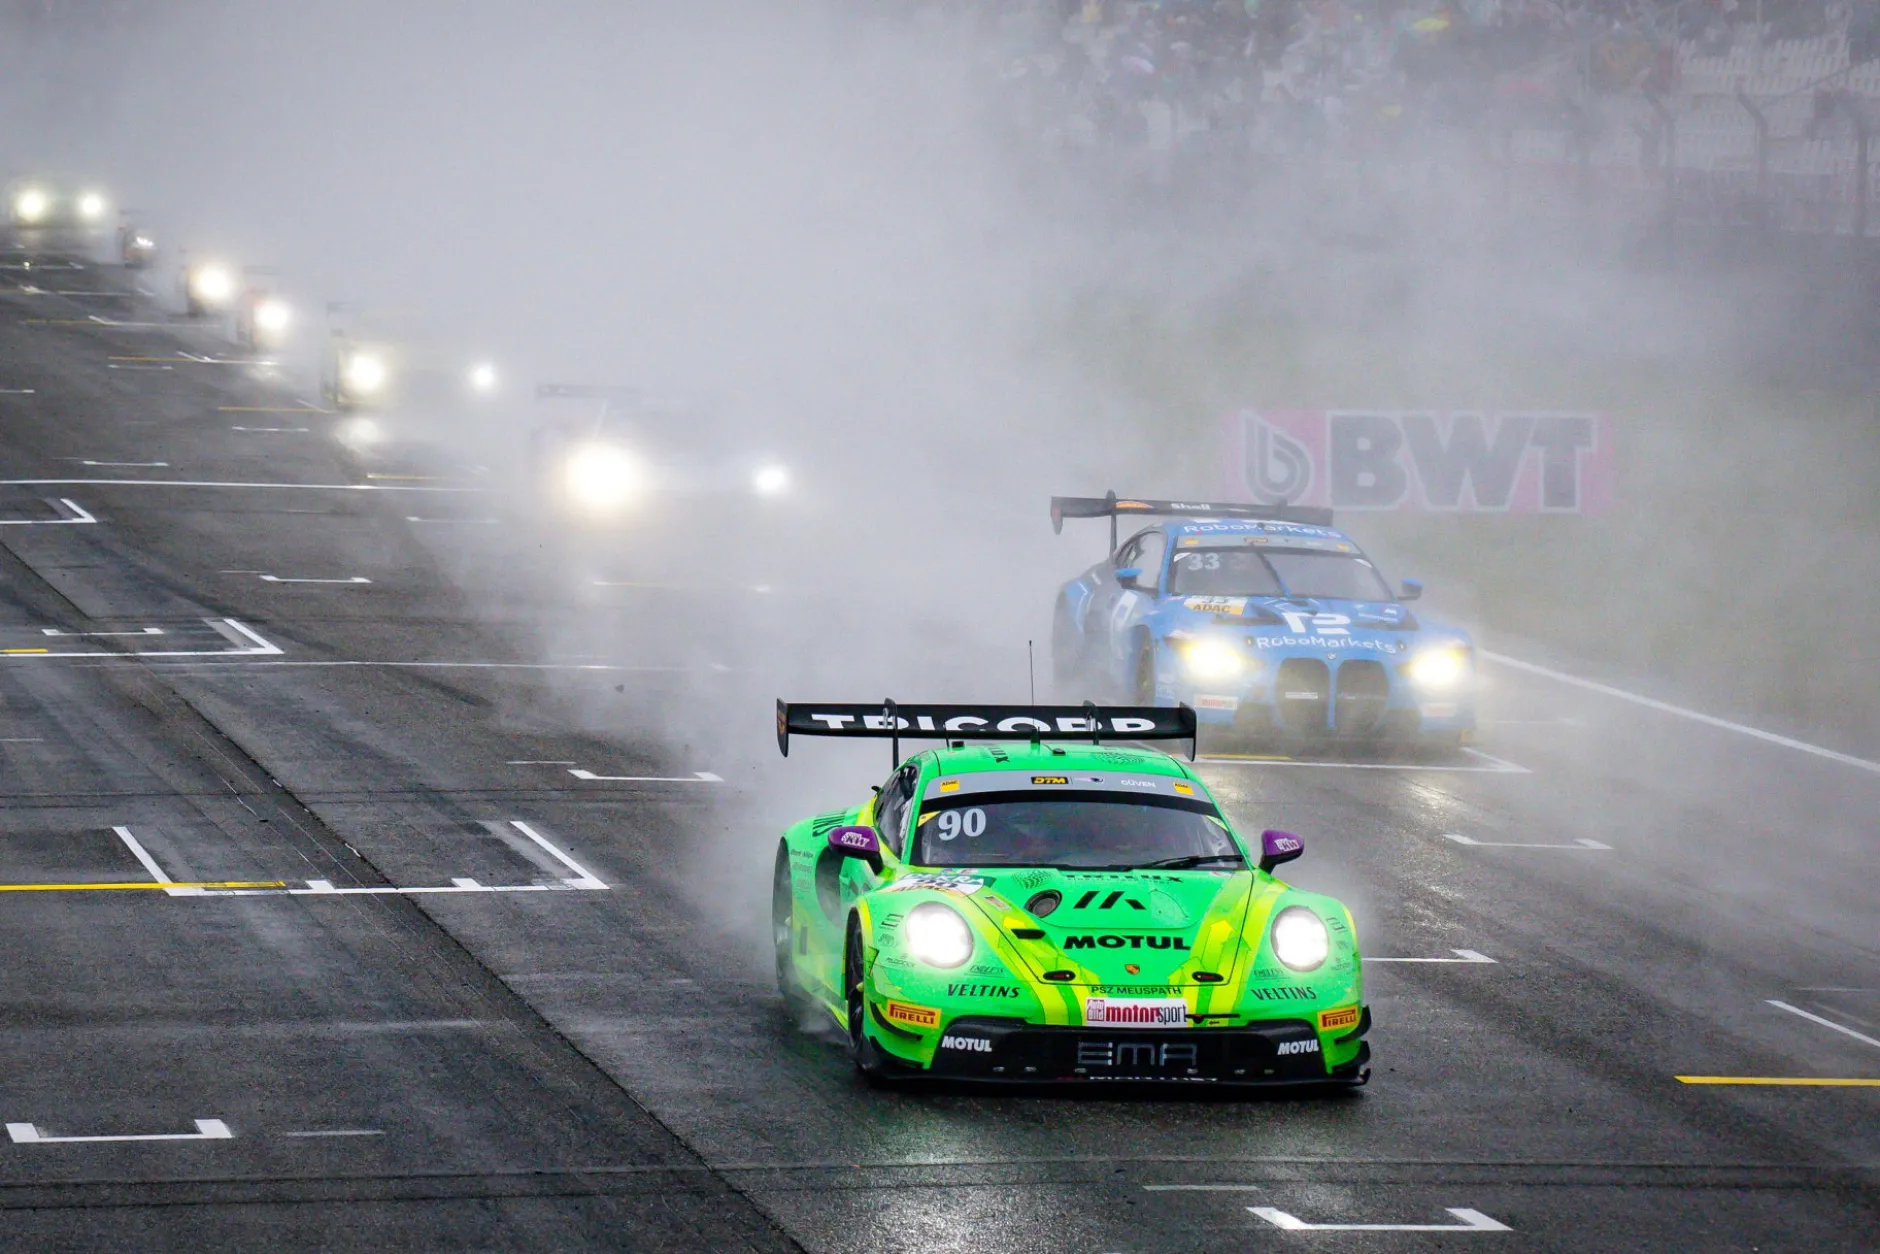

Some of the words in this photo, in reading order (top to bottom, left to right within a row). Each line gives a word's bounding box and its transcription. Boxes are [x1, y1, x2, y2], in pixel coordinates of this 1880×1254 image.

[1327, 410, 1598, 511] BWT
[1187, 552, 1220, 571] 33
[1192, 603, 1231, 613] ADAC
[1255, 634, 1397, 654] RoboMarkets
[1033, 777, 1067, 785] DTM
[938, 808, 987, 841] 90
[1063, 935, 1191, 951] MOTUL
[947, 983, 1021, 998] VELTINS
[1091, 986, 1114, 994] PSZ
[1116, 986, 1182, 995] MEUSPATH
[1250, 986, 1318, 1001] VELTINS
[889, 1003, 936, 1024] PIRELLI
[1321, 1008, 1357, 1028] PIRELLI
[941, 1035, 993, 1053] MOTUL
[1277, 1039, 1320, 1056] MOTUL
